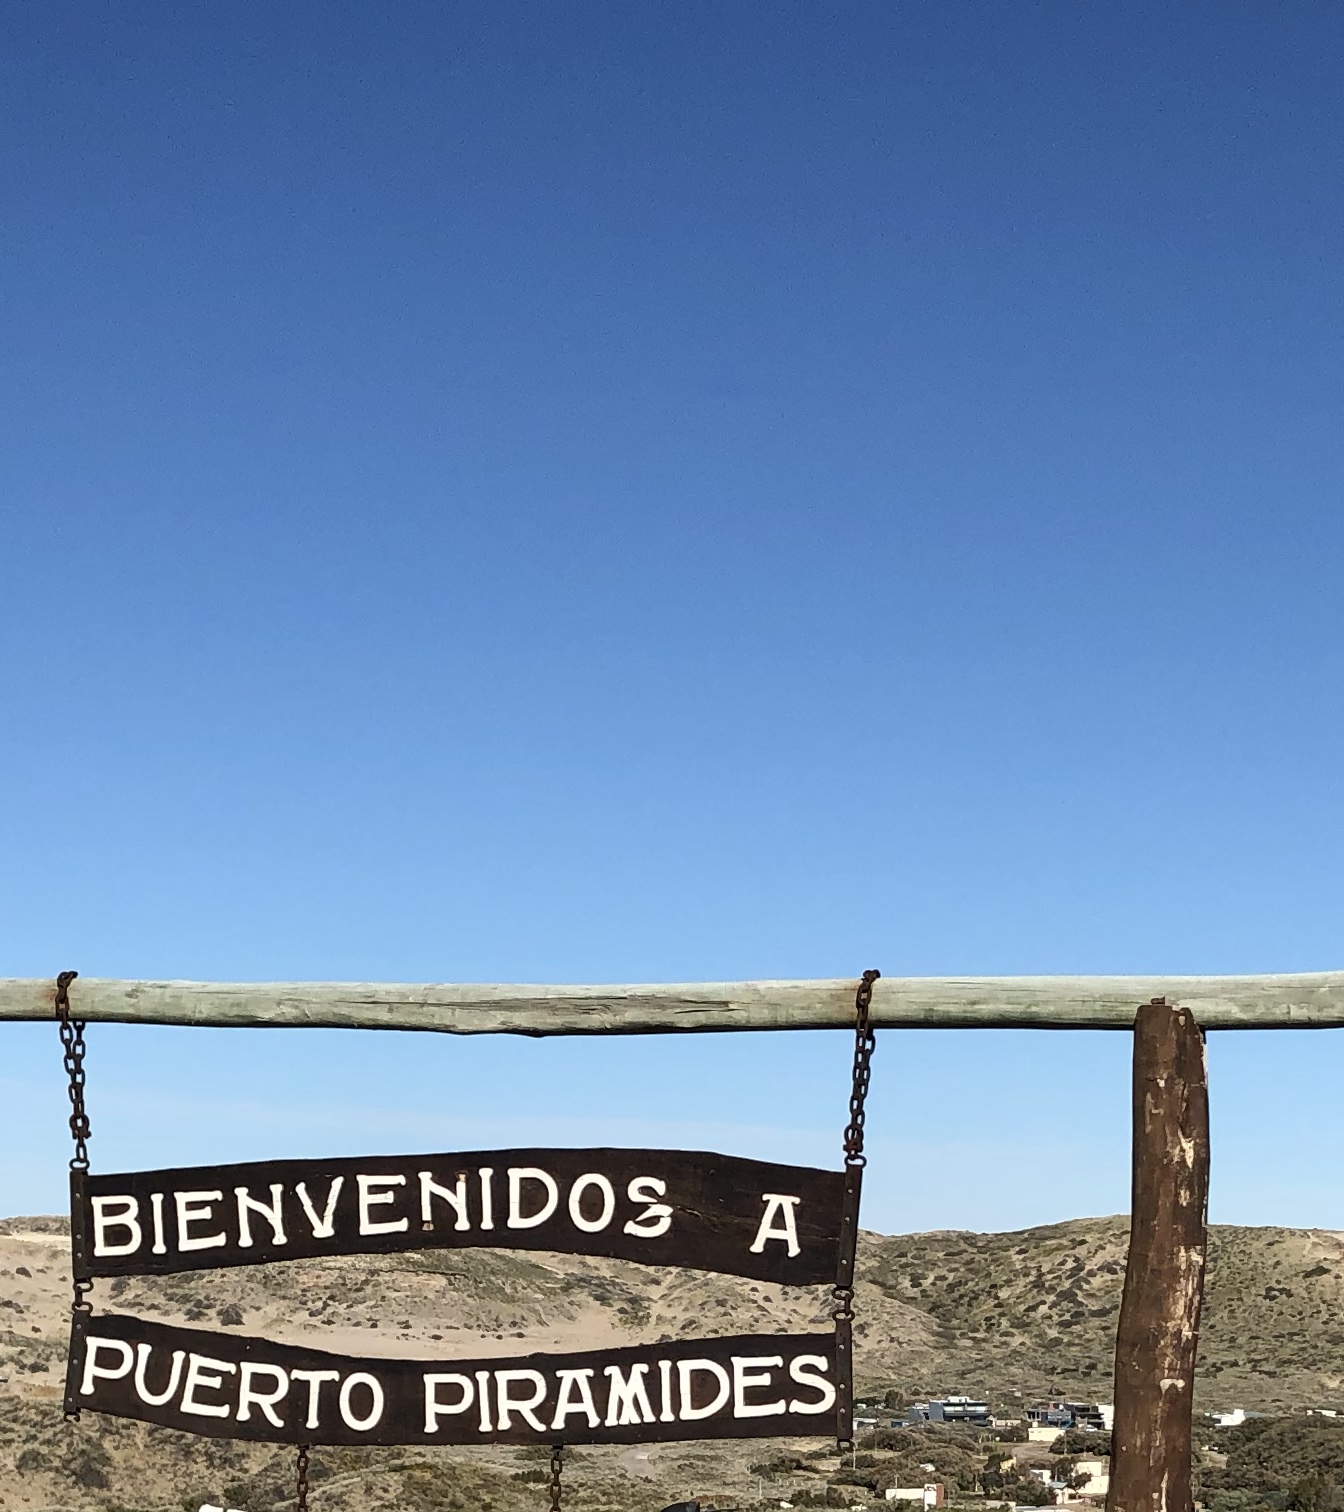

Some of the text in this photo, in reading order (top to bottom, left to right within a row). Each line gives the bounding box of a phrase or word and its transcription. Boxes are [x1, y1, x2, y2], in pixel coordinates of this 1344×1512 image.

[90, 1167, 802, 1258] BIENVENIDOS A
[79, 1336, 838, 1433] PUERTO PIRAMIDES
